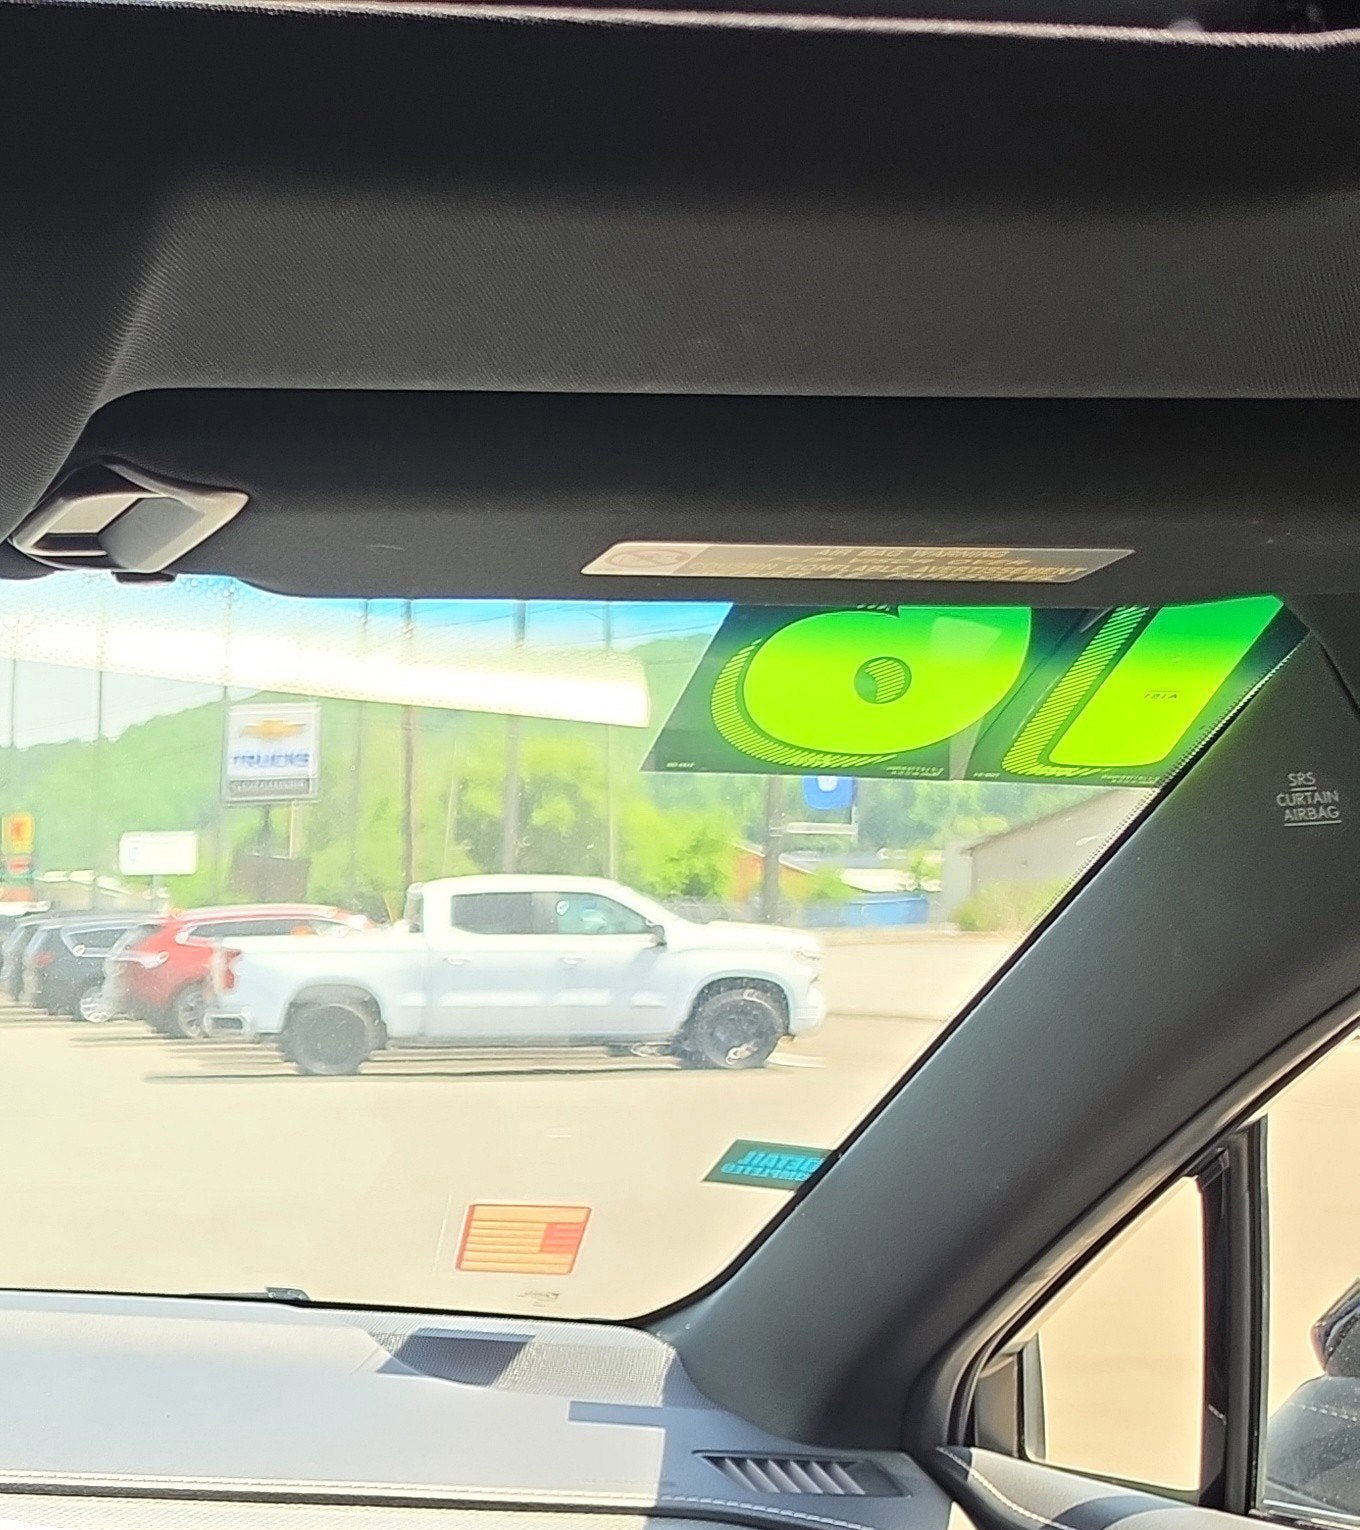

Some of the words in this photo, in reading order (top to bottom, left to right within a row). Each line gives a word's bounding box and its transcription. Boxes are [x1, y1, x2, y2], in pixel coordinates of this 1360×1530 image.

[1288, 772, 1316, 786] SRS
[1276, 790, 1339, 806] CURTAIN
[1284, 805, 1340, 821] AIRBAG
